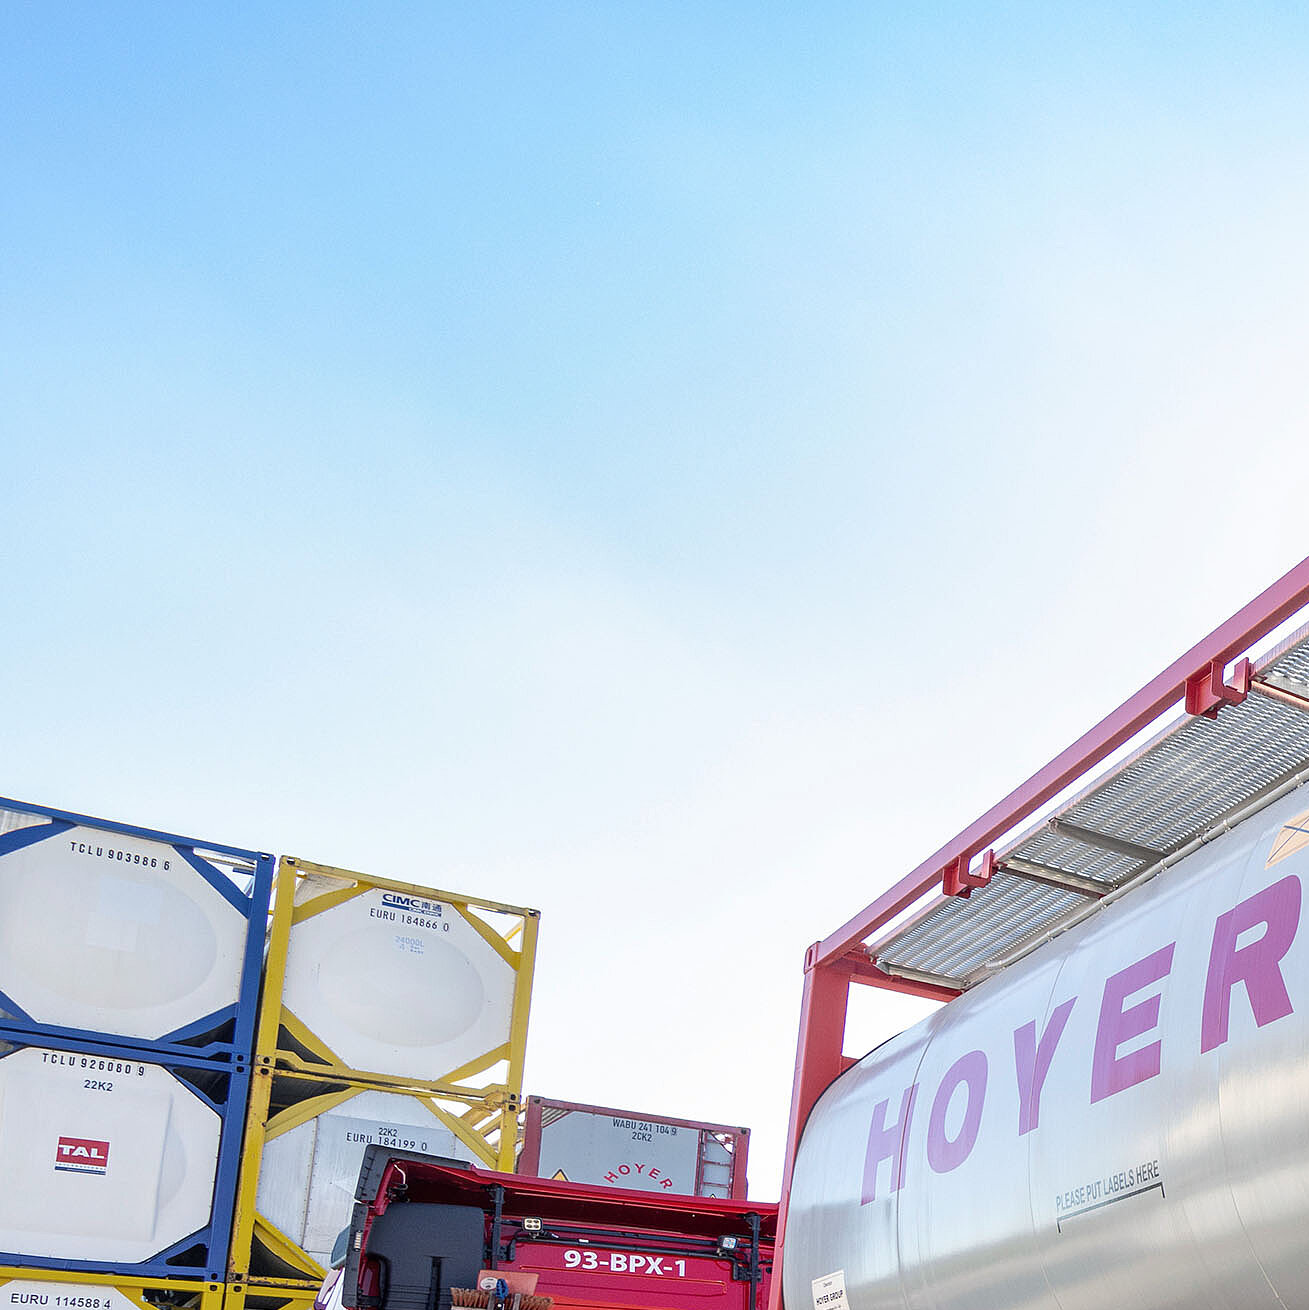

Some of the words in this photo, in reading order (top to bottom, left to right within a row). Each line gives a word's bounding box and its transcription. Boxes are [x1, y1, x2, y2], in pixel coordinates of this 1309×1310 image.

[69, 841, 103, 857] TCLU
[108, 849, 157, 868] 903986
[163, 861, 171, 871] 6
[382, 894, 420, 908] CIMC
[370, 908, 396, 921] EURU
[401, 914, 438, 930] 184866
[860, 875, 1303, 1207] HOYER
[42, 1053, 76, 1066] TCLU
[80, 1058, 132, 1074] 926080
[138, 1066, 145, 1077] 9
[84, 1079, 114, 1092] 22K2
[379, 1127, 398, 1137] 22K2
[613, 1118, 637, 1130] WABU
[638, 1122, 652, 1132] 241
[346, 1132, 372, 1144] EURU
[379, 1137, 415, 1149] 184199
[58, 1144, 104, 1159] TAL
[603, 1163, 673, 1189] HOYER
[1056, 1187, 1085, 1213] PLEASE
[1086, 1181, 1102, 1201] PUT
[1103, 1168, 1135, 1195] LABELS
[1136, 1160, 1160, 1184] HERE
[564, 1250, 686, 1277] 93-BPX-1
[10, 1293, 49, 1305] EURU
[55, 1296, 100, 1309] 114588
